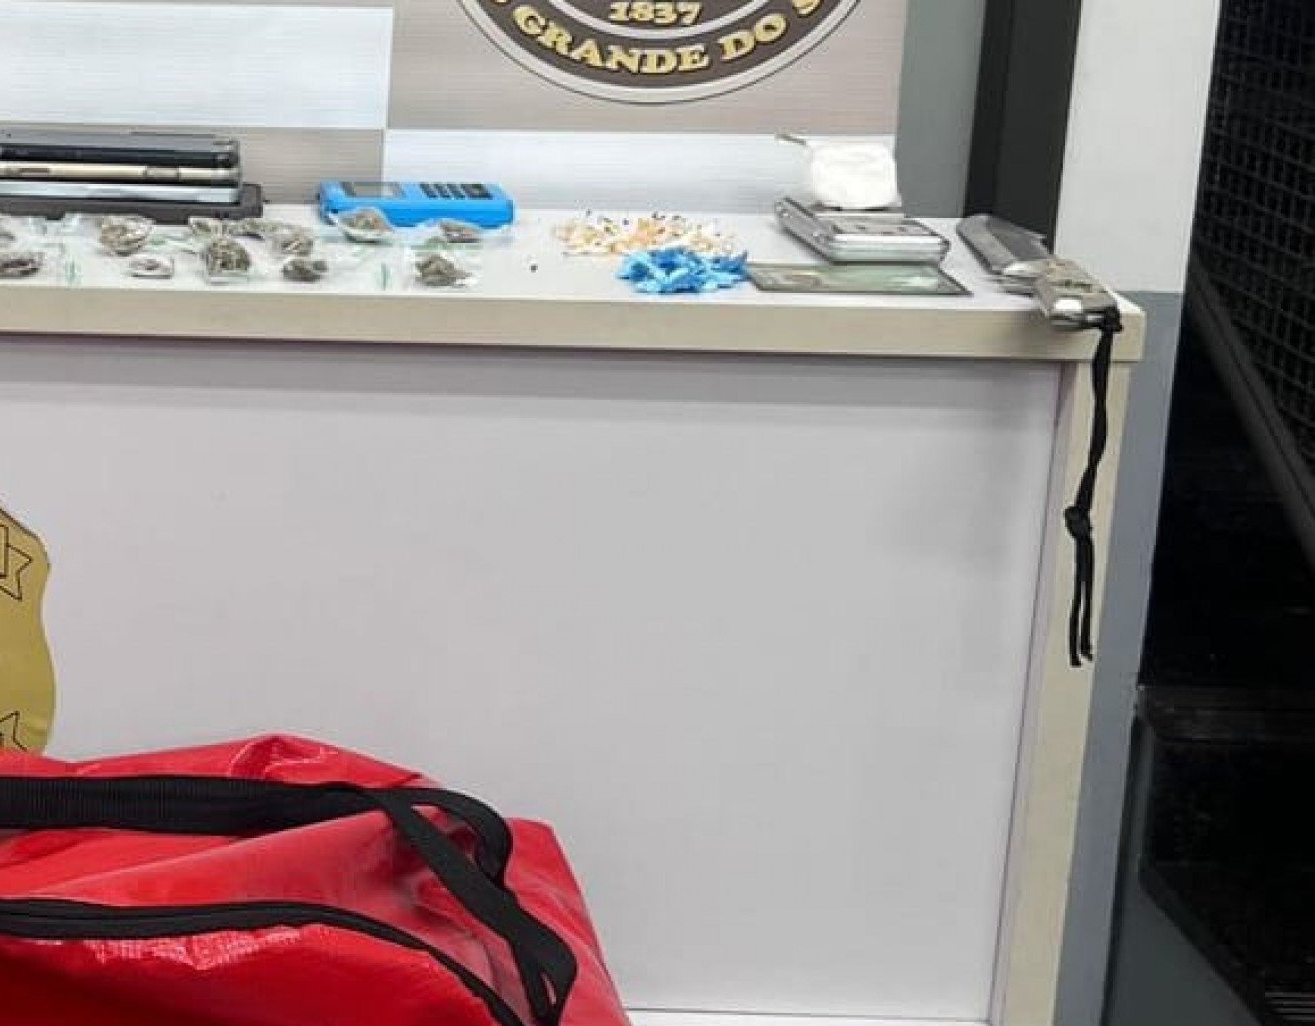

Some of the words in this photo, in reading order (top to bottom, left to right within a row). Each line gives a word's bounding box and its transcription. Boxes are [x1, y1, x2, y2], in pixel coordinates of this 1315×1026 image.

[608, 1, 702, 25] 1837
[512, 5, 710, 74] GRANDE
[719, 13, 787, 60] DO
